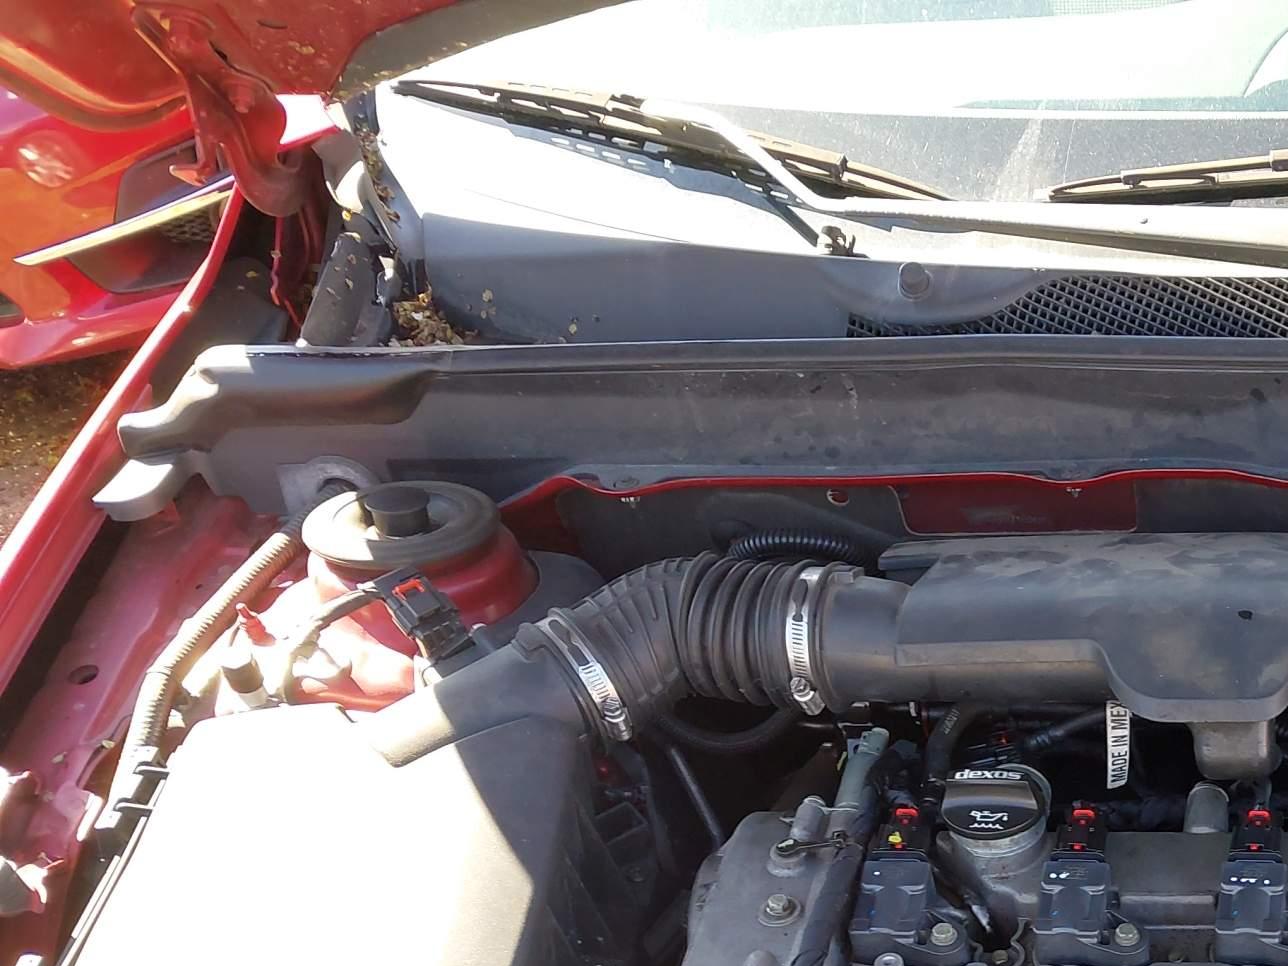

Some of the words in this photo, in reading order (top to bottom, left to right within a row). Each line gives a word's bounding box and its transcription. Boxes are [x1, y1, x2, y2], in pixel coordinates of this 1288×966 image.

[1109, 702, 1129, 731] MEX
[1111, 734, 1129, 748] IN
[954, 768, 1025, 780] dexos
[1110, 750, 1128, 784] MADE
